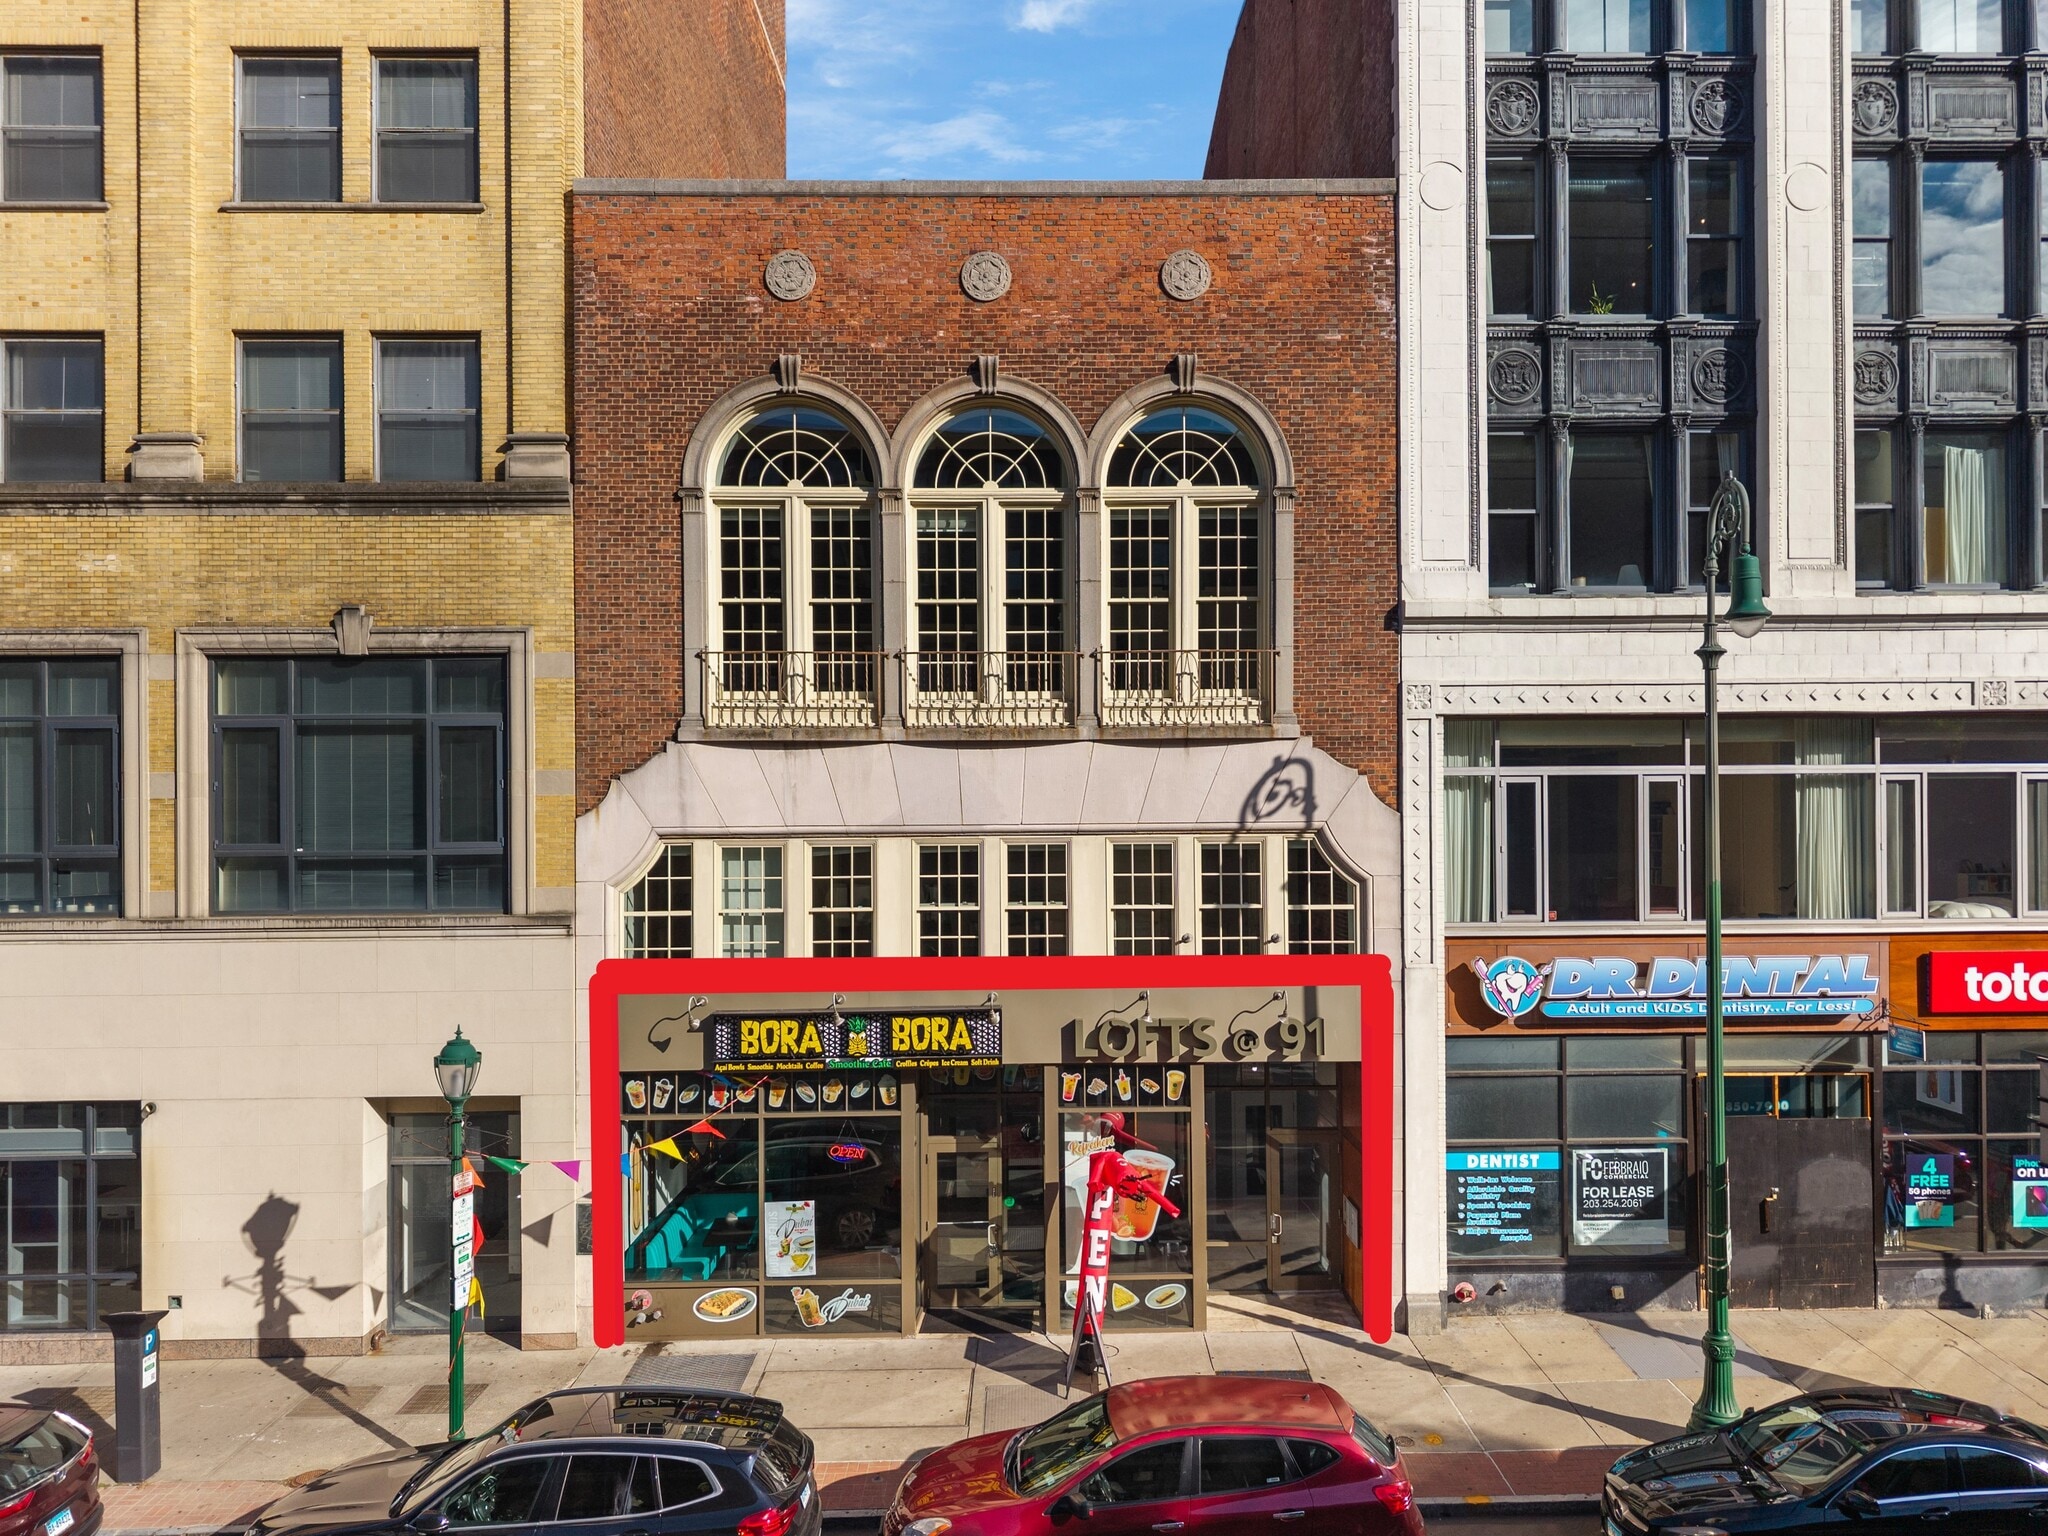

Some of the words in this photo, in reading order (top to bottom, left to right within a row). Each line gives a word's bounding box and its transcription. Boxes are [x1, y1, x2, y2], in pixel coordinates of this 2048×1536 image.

[1566, 1003, 1611, 1015] Adult
[1615, 1003, 1648, 1015] and
[1652, 1002, 1694, 1015] KIDS
[1816, 1000, 1857, 1012] Less!
[740, 1019, 823, 1055] BORA
[891, 1016, 974, 1052] BORA
[1074, 1016, 1218, 1059] LOFTS
[1232, 1028, 1260, 1057] @
[1278, 1016, 1326, 1057] 91
[728, 1061, 745, 1071] Bowls
[747, 1061, 774, 1071] Smoothie
[775, 1060, 804, 1070] Mocktails
[805, 1060, 824, 1070] Coffee
[828, 1058, 870, 1069] Smoothie
[941, 1058, 951, 1067] Ice
[951, 1058, 969, 1067] Cream
[970, 1058, 983, 1067] Soft
[983, 1057, 1000, 1066] Drink
[829, 1145, 867, 1159] OPEN
[1466, 1153, 1540, 1169] DENTIST
[1603, 1160, 1649, 1175] FEBBRAIO
[1922, 1157, 1938, 1175] 4
[1500, 1175, 1533, 1184] Welcome
[2016, 1167, 2037, 1179] on
[1910, 1174, 1950, 1188] FREE
[1466, 1185, 1506, 1193] Affordable
[1508, 1185, 1536, 1194] Quality
[1582, 1186, 1609, 1199] FOR
[1612, 1185, 1655, 1198] LEASE
[1908, 1187, 1920, 1196] 5G
[1921, 1187, 1951, 1197] phones
[1466, 1193, 1501, 1201] Dentistry
[1583, 1198, 1643, 1209] 203.254.2061
[1466, 1202, 1496, 1211] Spanish
[1497, 1201, 1531, 1210] Speaking
[1466, 1211, 1499, 1220] Payment
[1500, 1211, 1522, 1219] Plans
[1466, 1218, 1502, 1226] Available
[1085, 1185, 1114, 1313] PEN
[821, 1288, 871, 1322] Dubai
[145, 1333, 153, 1351] P
